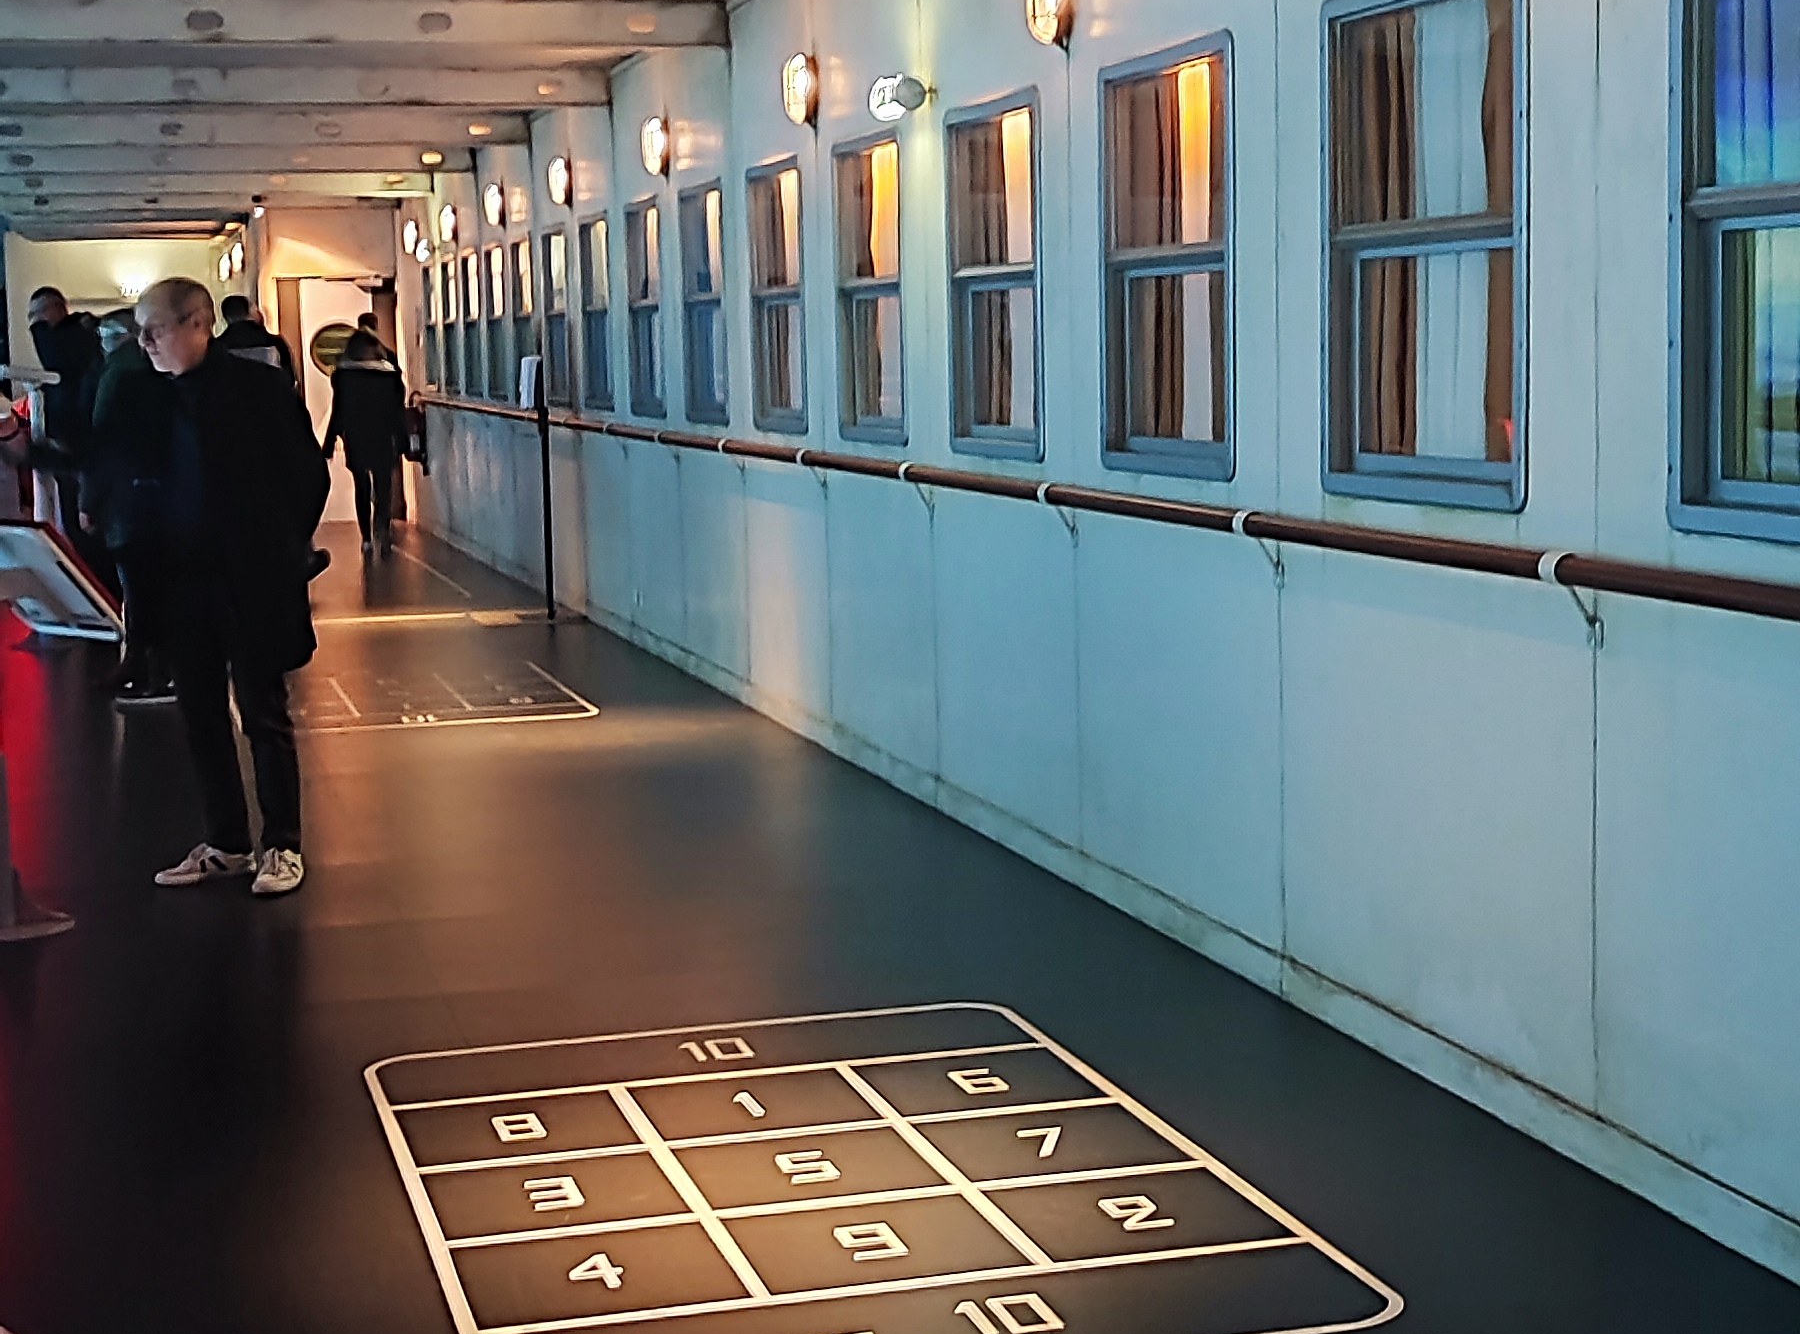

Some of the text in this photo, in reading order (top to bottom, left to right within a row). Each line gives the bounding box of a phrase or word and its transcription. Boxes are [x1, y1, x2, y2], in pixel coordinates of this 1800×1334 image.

[677, 1032, 755, 1061] 10
[950, 1069, 1009, 1094] 6
[733, 1092, 765, 1116] 1
[492, 1113, 548, 1141] 8
[1017, 1127, 1062, 1157] 7
[775, 1151, 840, 1184] 5
[524, 1177, 586, 1211] 3
[1098, 1196, 1175, 1230] 2
[834, 1223, 909, 1260] 9
[569, 1254, 623, 1288] 4
